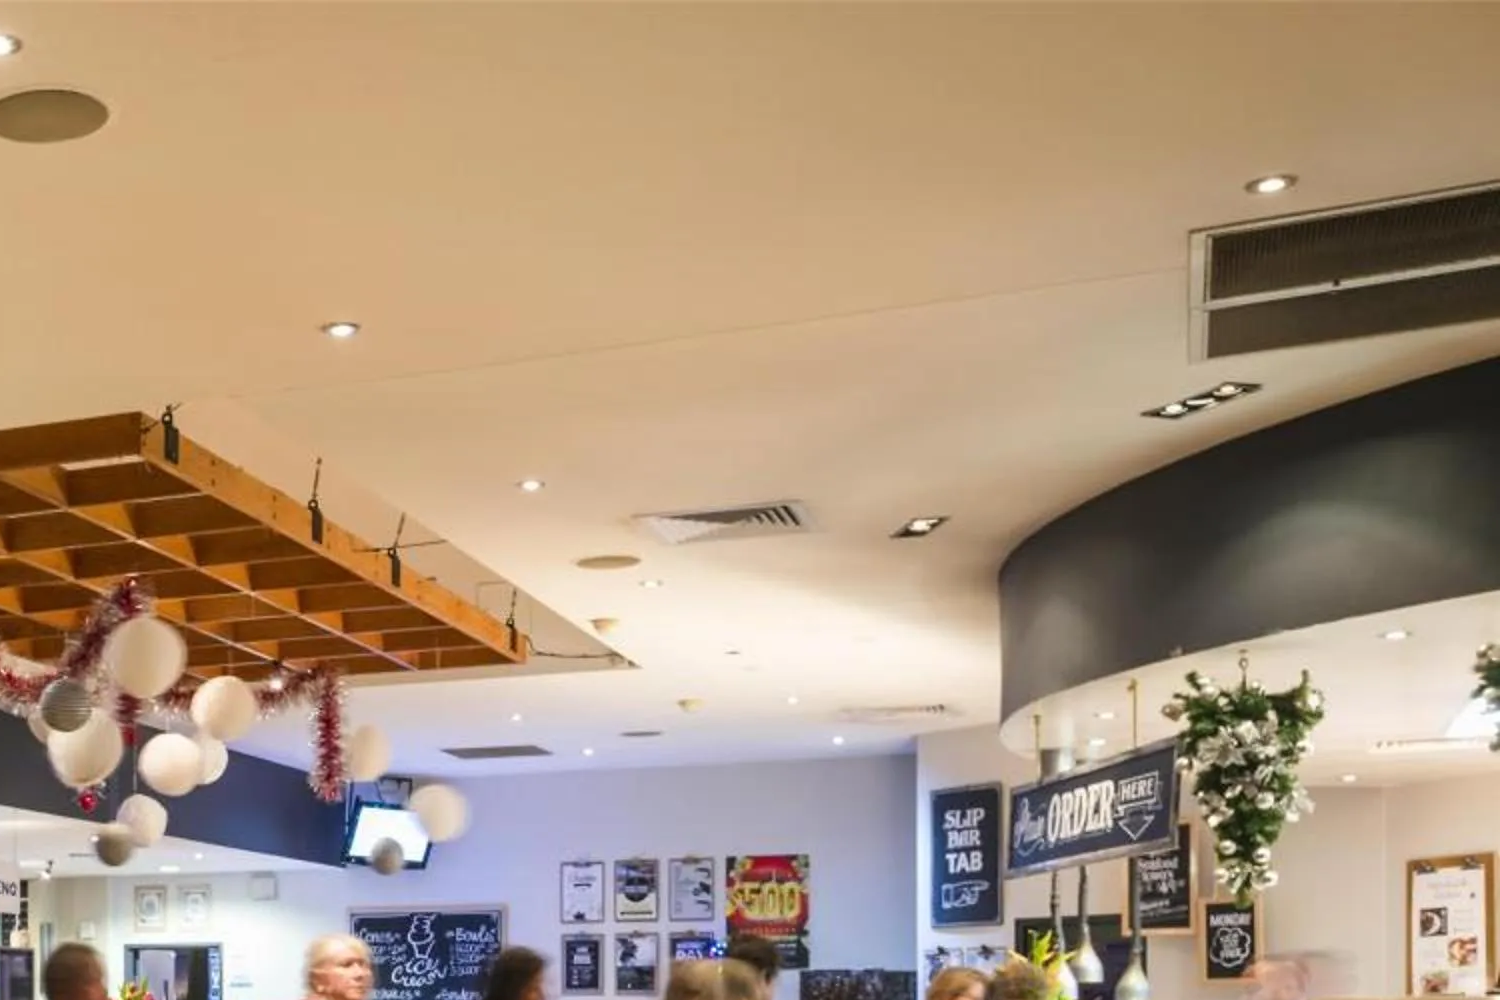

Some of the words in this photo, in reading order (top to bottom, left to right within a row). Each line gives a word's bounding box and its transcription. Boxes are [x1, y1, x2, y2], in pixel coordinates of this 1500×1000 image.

[943, 808, 985, 830] SLIP
[1047, 779, 1116, 848] ORDER
[1121, 778, 1154, 801] HERE
[947, 829, 981, 849] BAR
[945, 852, 983, 874] TAB
